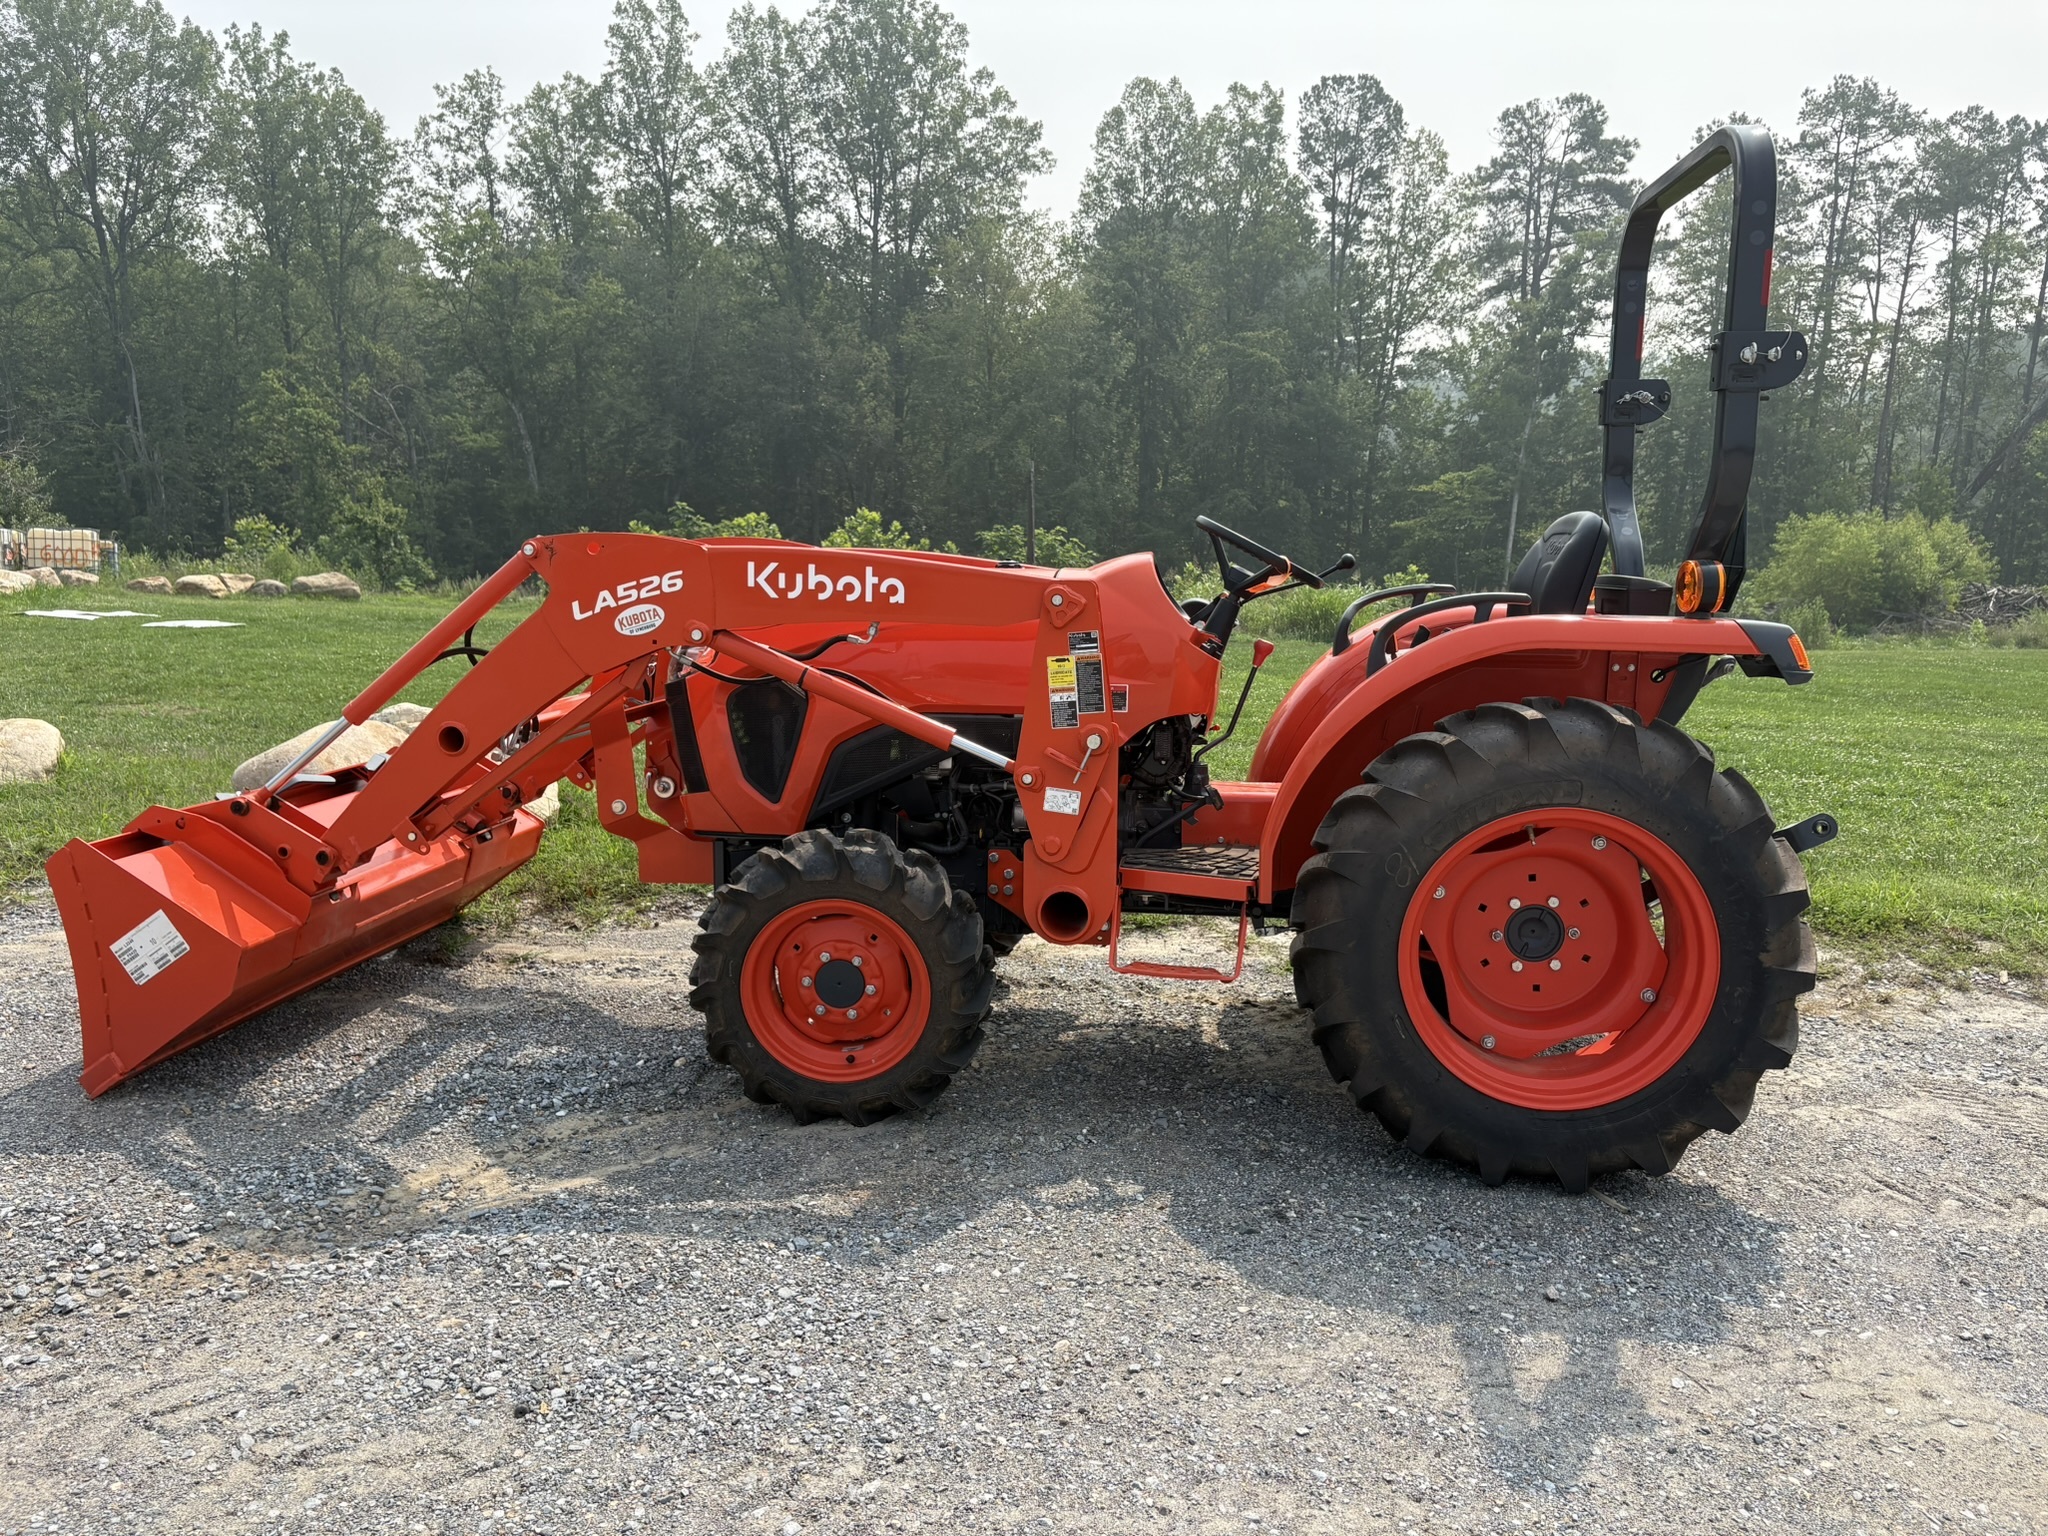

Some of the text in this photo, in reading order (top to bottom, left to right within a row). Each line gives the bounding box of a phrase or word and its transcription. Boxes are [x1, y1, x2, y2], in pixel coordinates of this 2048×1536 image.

[571, 570, 684, 621] LA526
[747, 561, 905, 604] Kubota
[617, 608, 662, 631] KUBOTA
